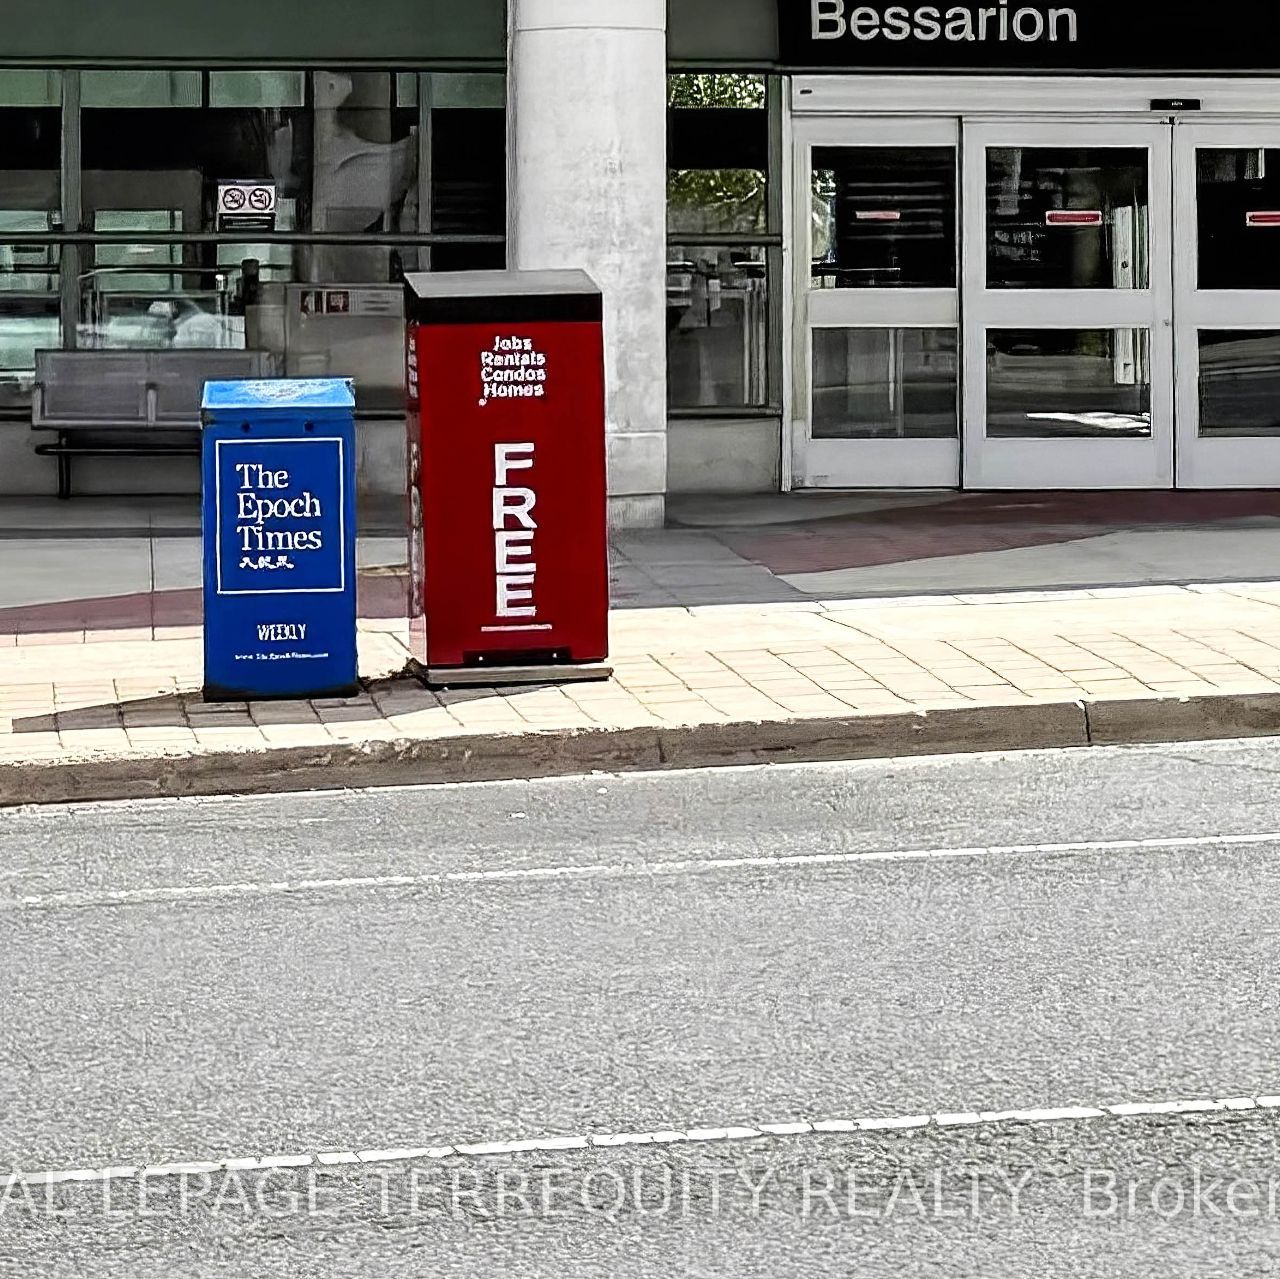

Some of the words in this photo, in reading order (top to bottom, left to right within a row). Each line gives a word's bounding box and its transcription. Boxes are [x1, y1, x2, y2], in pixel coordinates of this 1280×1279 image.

[493, 336, 532, 351] Jobs
[481, 351, 546, 366] Rentals
[481, 366, 547, 382] Condos
[484, 383, 545, 397] Homes
[236, 463, 289, 489] The
[237, 492, 322, 524] Epoch
[237, 525, 322, 551] Times
[493, 442, 537, 617] FREE
